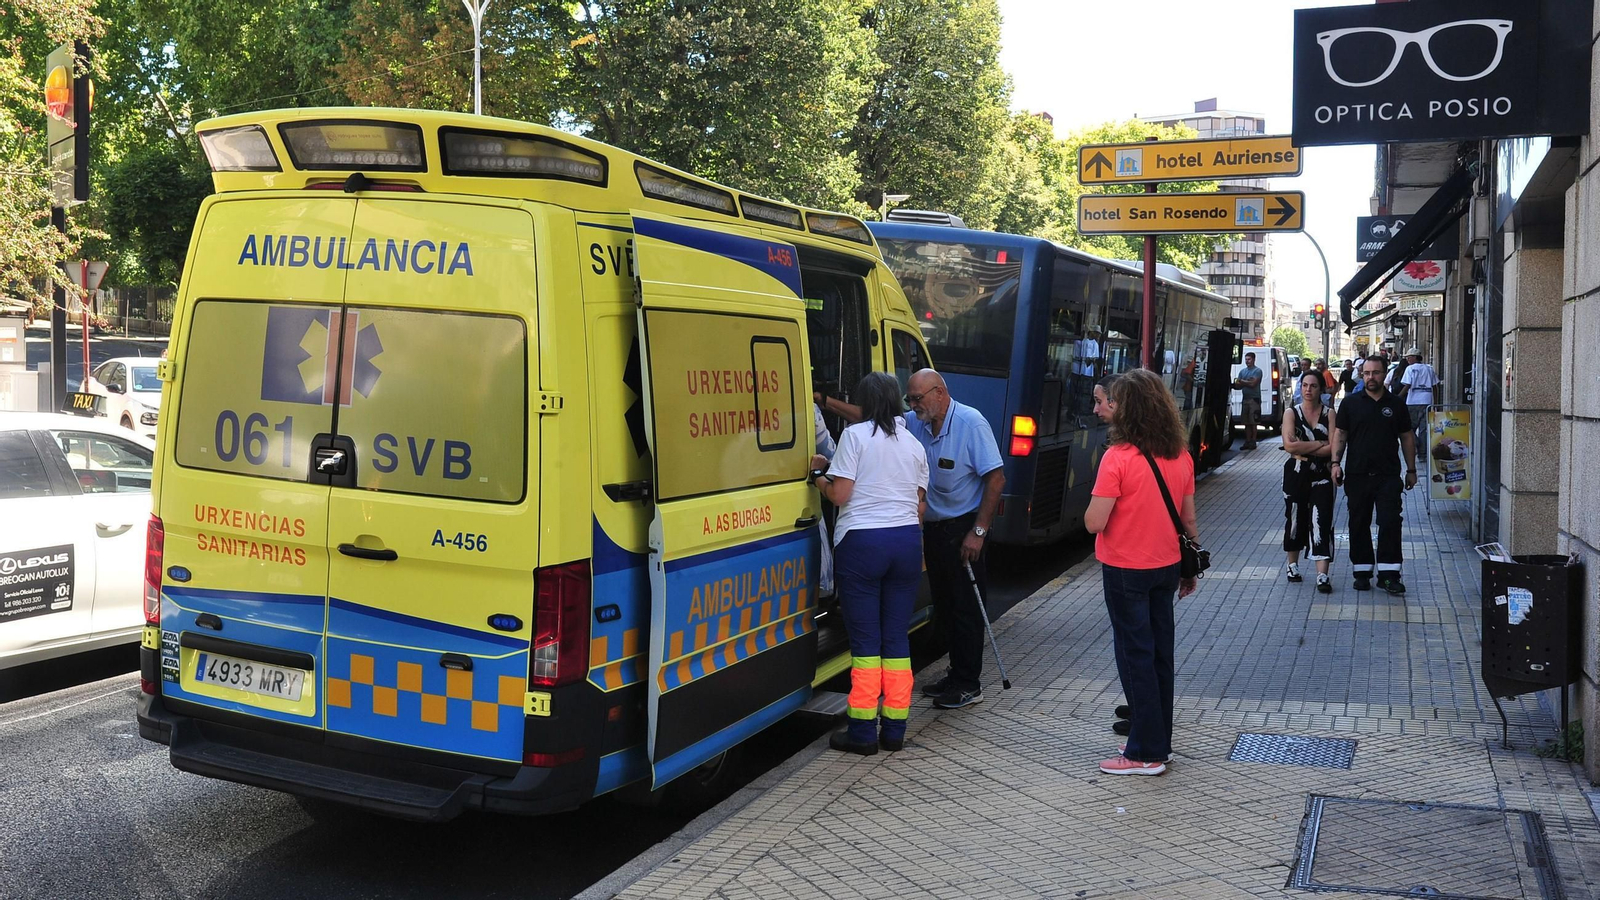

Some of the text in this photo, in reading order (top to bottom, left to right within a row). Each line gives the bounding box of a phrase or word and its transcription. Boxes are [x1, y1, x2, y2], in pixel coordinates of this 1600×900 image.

[1314, 96, 1512, 124] OPTICA POSIO
[1156, 149, 1295, 169] hotel Auriense
[1084, 206, 1228, 220] hotel San Rosendo
[237, 234, 474, 276] AMBULANCIA
[767, 246, 793, 267] A-456
[1398, 276, 1444, 290] Plantas medicinales
[687, 370, 779, 395] URXENCIAS
[73, 393, 94, 409] TAXI
[689, 408, 780, 438] SANITARIAS
[215, 409, 293, 468] 061
[372, 433, 472, 480] SVB
[195, 504, 306, 537] URXENCIAS
[703, 505, 772, 535] A. AS BURGAS
[197, 533, 307, 566] SANITARIAS
[431, 529, 488, 552] A-456
[17, 552, 69, 569] LEXUS
[0, 567, 69, 586] BREOGAN AUTOLUX
[687, 555, 808, 624] AMBULANCIA
[207, 659, 254, 687] 4933
[259, 667, 298, 695] MRY
